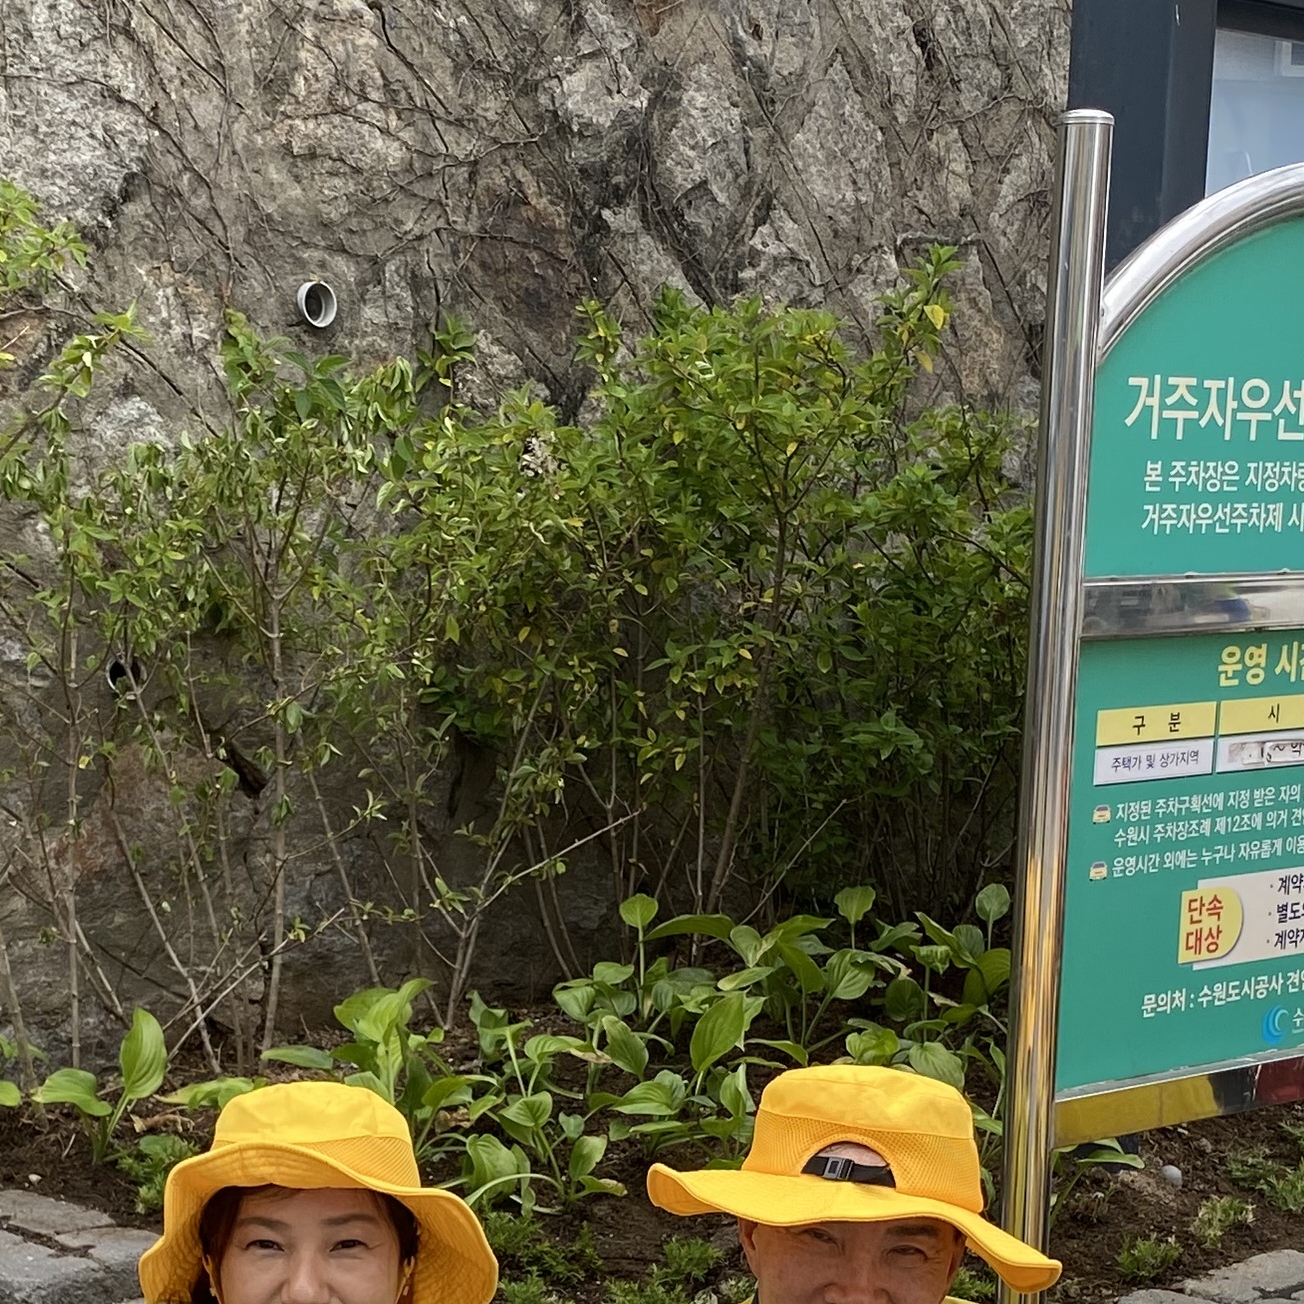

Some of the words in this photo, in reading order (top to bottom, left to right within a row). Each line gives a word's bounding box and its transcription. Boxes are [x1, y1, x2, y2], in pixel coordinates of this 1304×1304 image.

[1144, 460, 1162, 492] 본
[1168, 460, 1240, 492] 주차장은
[1141, 502, 1284, 535] 거주자우선주차제
[1218, 643, 1268, 687] 운영
[1111, 754, 1142, 773] 주택가
[1146, 754, 1156, 769] 및
[1159, 749, 1199, 768] 상가지역
[1115, 800, 1152, 823] 지정된
[1154, 791, 1224, 818] 주차구획선에
[1227, 788, 1251, 811] 지정
[1253, 786, 1276, 807] 받은
[1278, 783, 1302, 805] 자의
[1113, 824, 1150, 848] 수원시
[1152, 817, 1211, 844] 주차장조례
[1213, 812, 1262, 836] 제12조에
[1265, 809, 1288, 830] 의거
[1111, 853, 1161, 878] 운영시간
[1162, 848, 1198, 871] 외에는
[1200, 843, 1236, 866] 누구나
[1238, 837, 1283, 862] 자유롭게
[1187, 893, 1225, 925] 단속
[1184, 924, 1223, 956] 대상
[1141, 987, 1187, 1019] 문의처
[1197, 976, 1284, 1007] 수원도시공사
